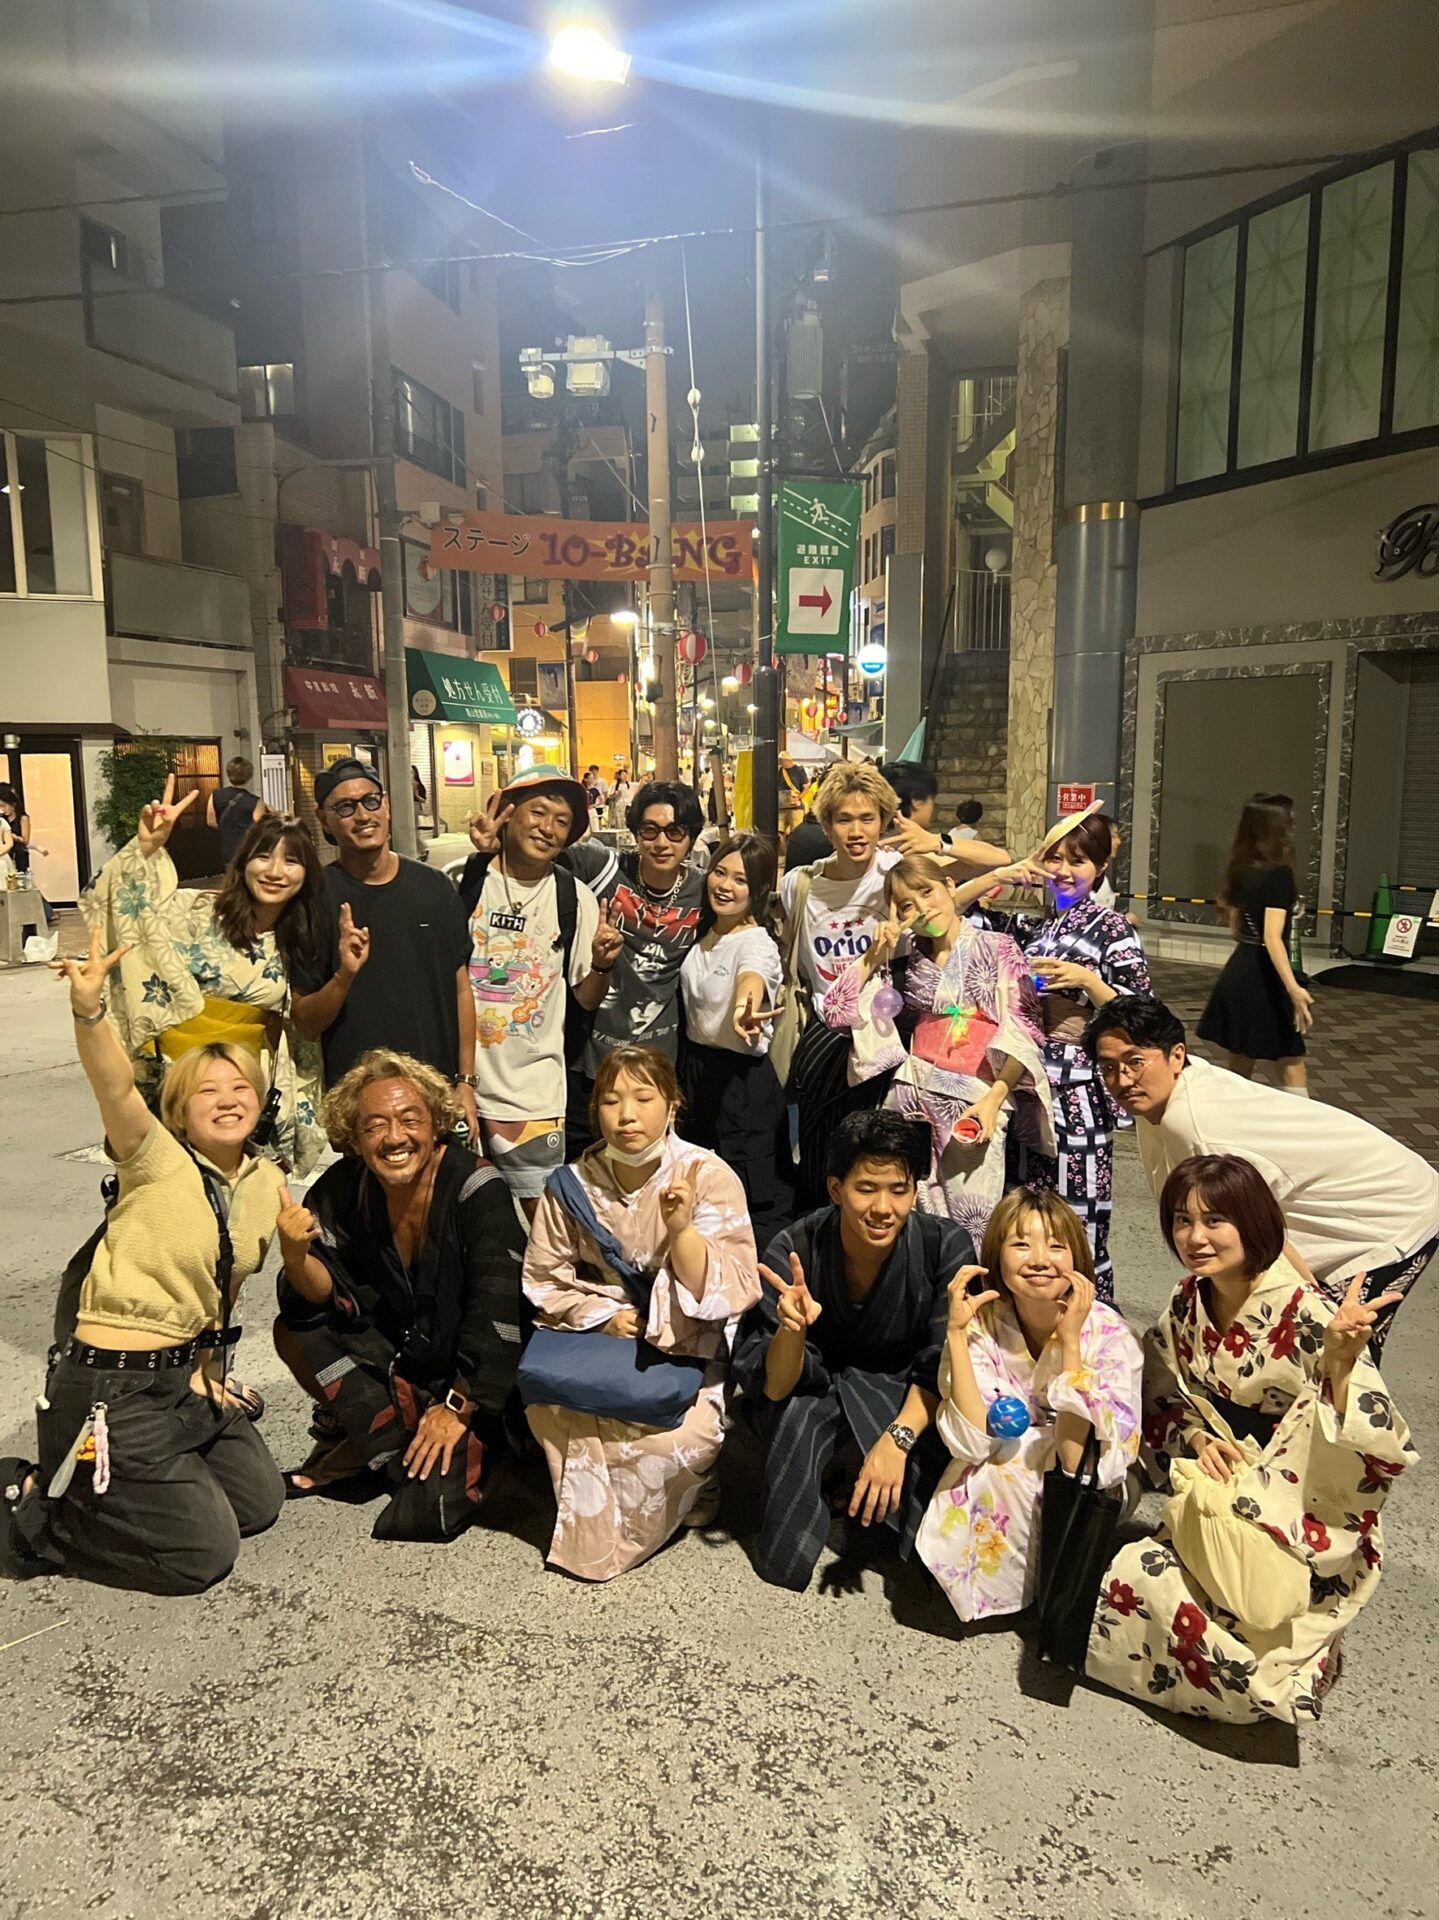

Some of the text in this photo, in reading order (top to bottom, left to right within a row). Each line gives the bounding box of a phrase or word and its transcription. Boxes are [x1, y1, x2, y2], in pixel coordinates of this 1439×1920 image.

[442, 527, 531, 557] ステージ
[803, 556, 832, 565] EXIT
[441, 676, 504, 705] 処方せん受付
[491, 914, 524, 932] KITH
